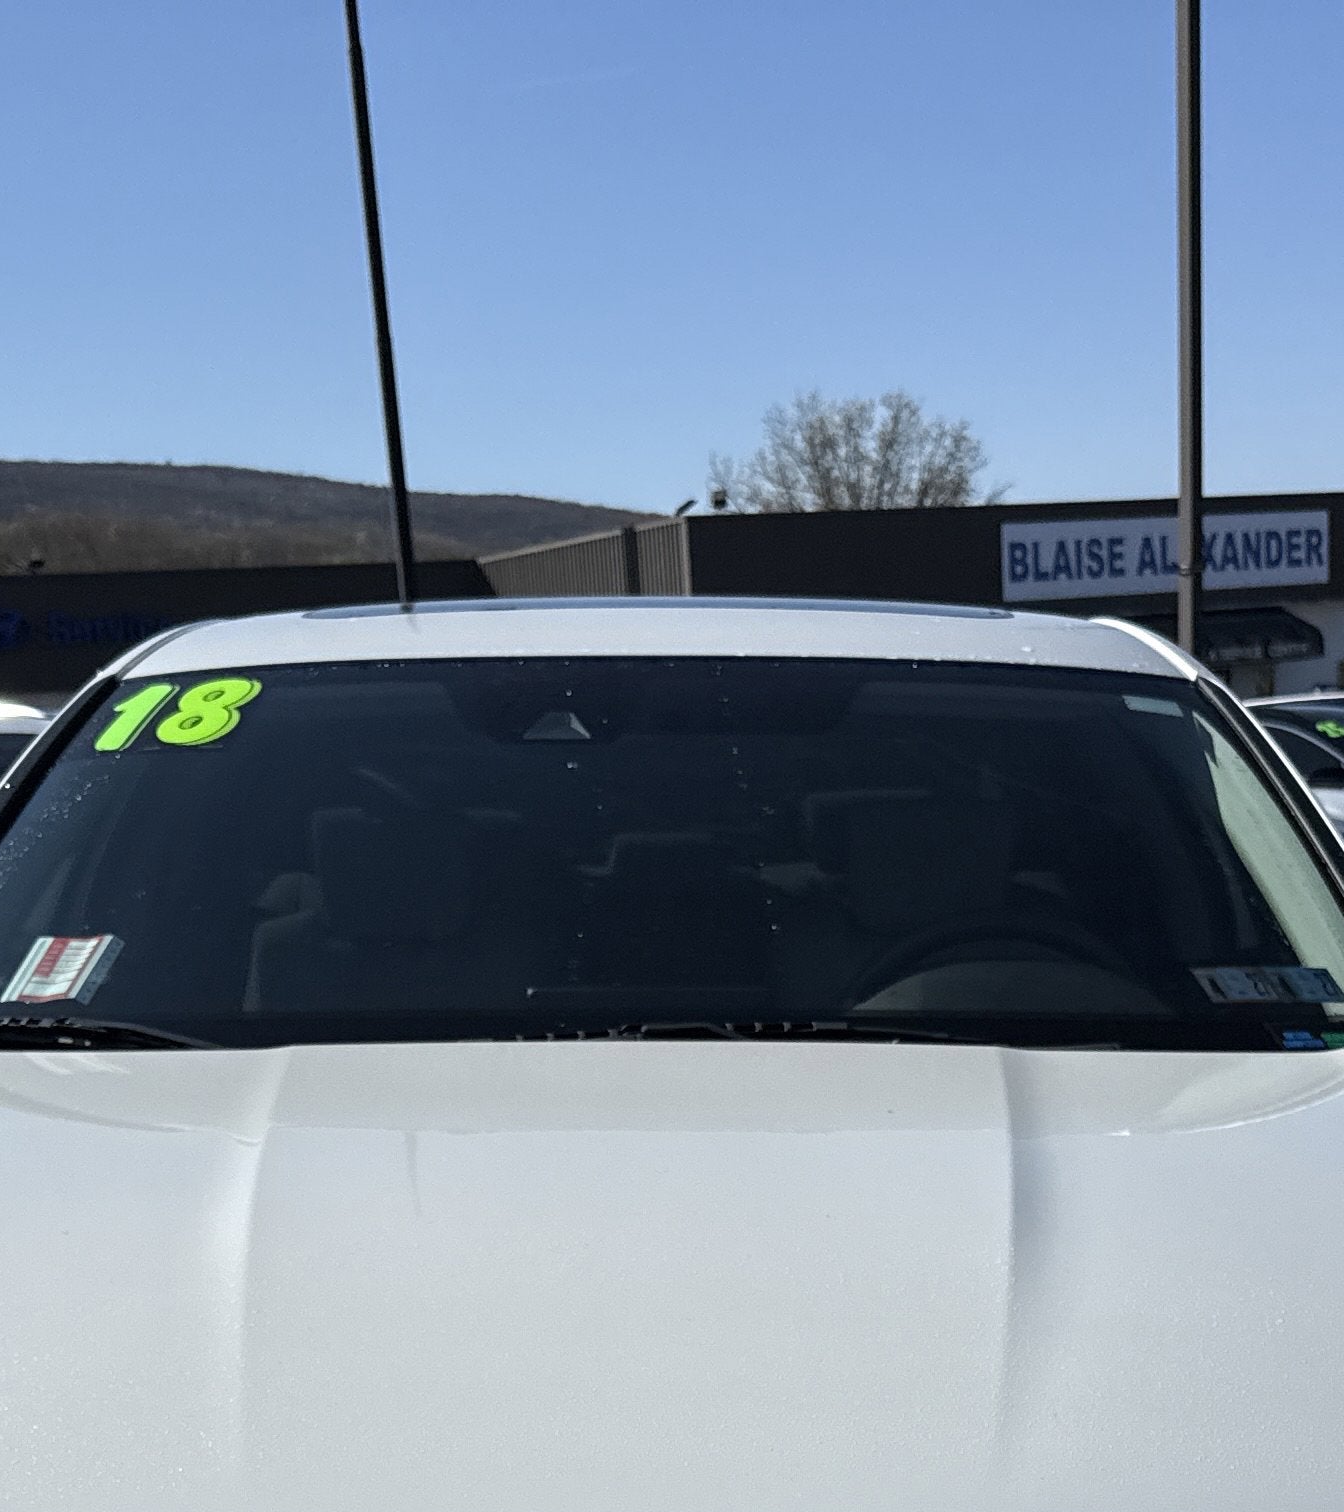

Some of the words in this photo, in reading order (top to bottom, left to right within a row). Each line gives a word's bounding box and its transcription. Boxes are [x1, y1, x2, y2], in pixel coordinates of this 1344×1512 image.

[1007, 536, 1126, 583] BLAISE
[1136, 528, 1324, 578] ALXANDER
[94, 678, 263, 752] 18
